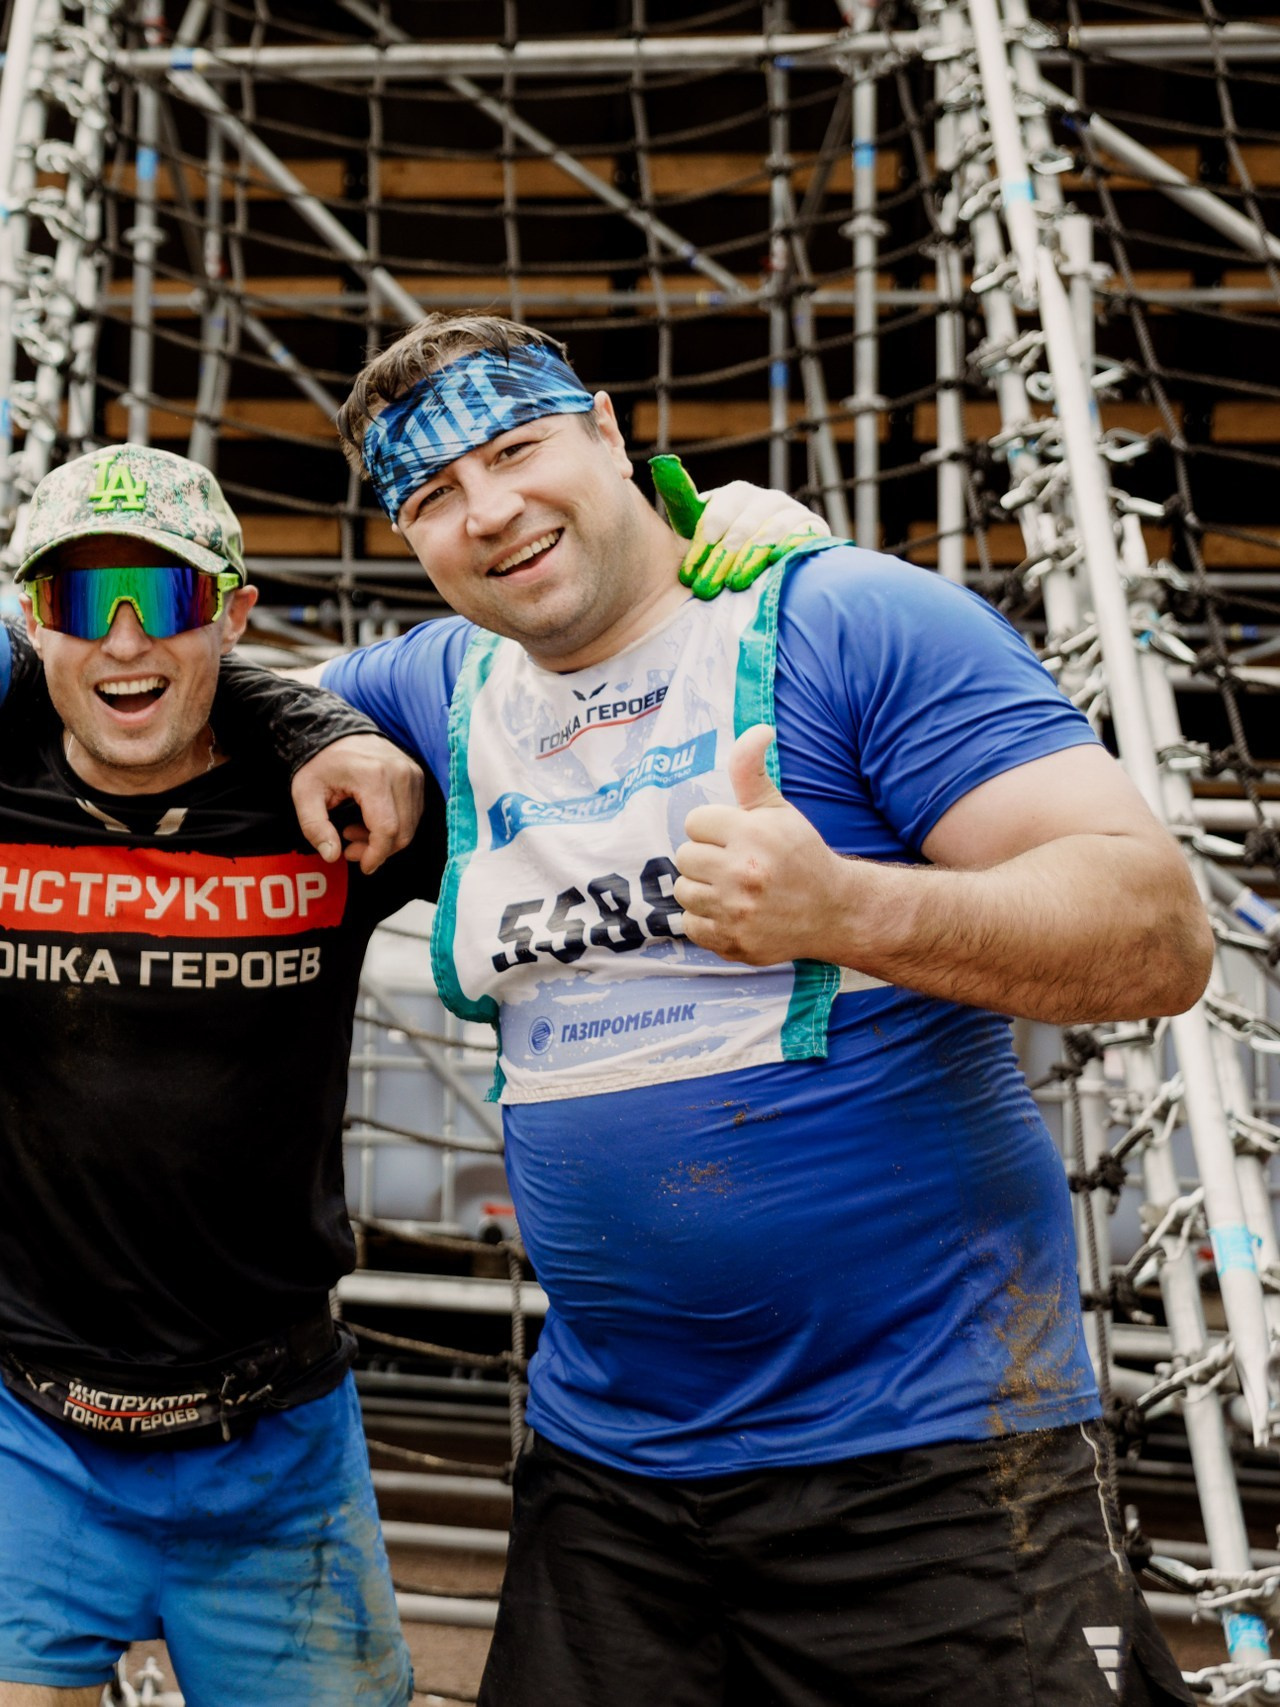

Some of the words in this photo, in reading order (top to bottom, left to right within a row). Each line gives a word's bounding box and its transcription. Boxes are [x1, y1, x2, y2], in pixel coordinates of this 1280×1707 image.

[90, 456, 147, 512] LA
[539, 715, 581, 752] ГОНКА
[586, 686, 669, 724] ГЕРОЕВ
[492, 856, 689, 973] 5588
[139, 946, 321, 989] ГЕРОЕВ
[560, 1003, 696, 1043] ГАЗПРОМБАНК
[63, 1401, 124, 1432] ГОНКА
[130, 1407, 199, 1432] ГЕРОЕВ
